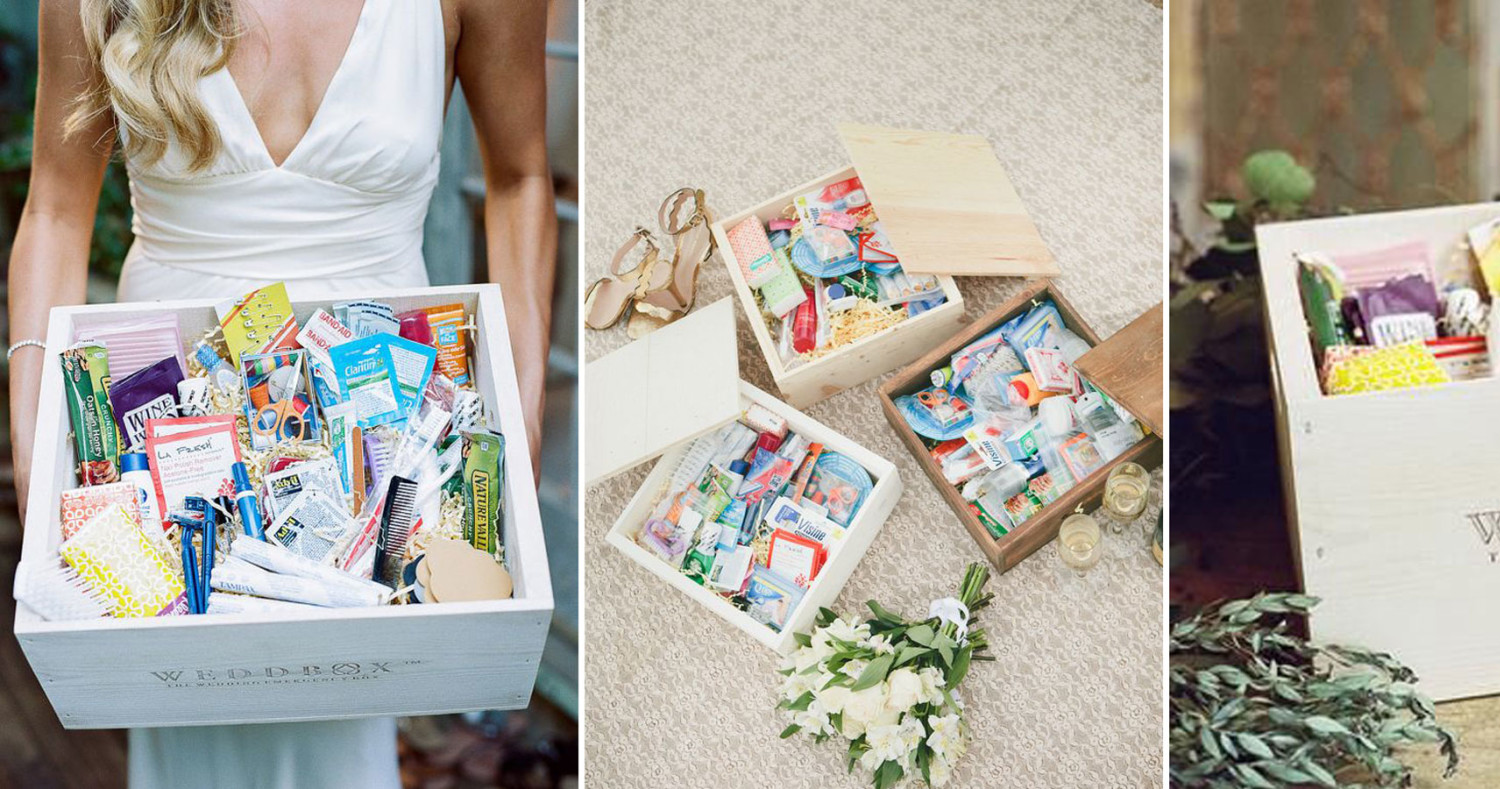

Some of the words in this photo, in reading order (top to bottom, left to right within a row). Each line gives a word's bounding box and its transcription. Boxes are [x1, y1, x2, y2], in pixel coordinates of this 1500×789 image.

[319, 311, 352, 338] BAND-AID
[306, 330, 331, 352] BAND-A
[345, 361, 376, 376] Claritin
[86, 395, 95, 413] Oats
[93, 428, 102, 458] Honey
[100, 404, 114, 444] CRUNCHY
[128, 397, 173, 432] WINE
[176, 439, 212, 454] FRESH
[474, 474, 488, 521] NATURE
[476, 522, 488, 551] VALL
[797, 518, 827, 541] Visine
[220, 581, 256, 592] TAMPAX
[150, 662, 391, 682] WEDDBOX
